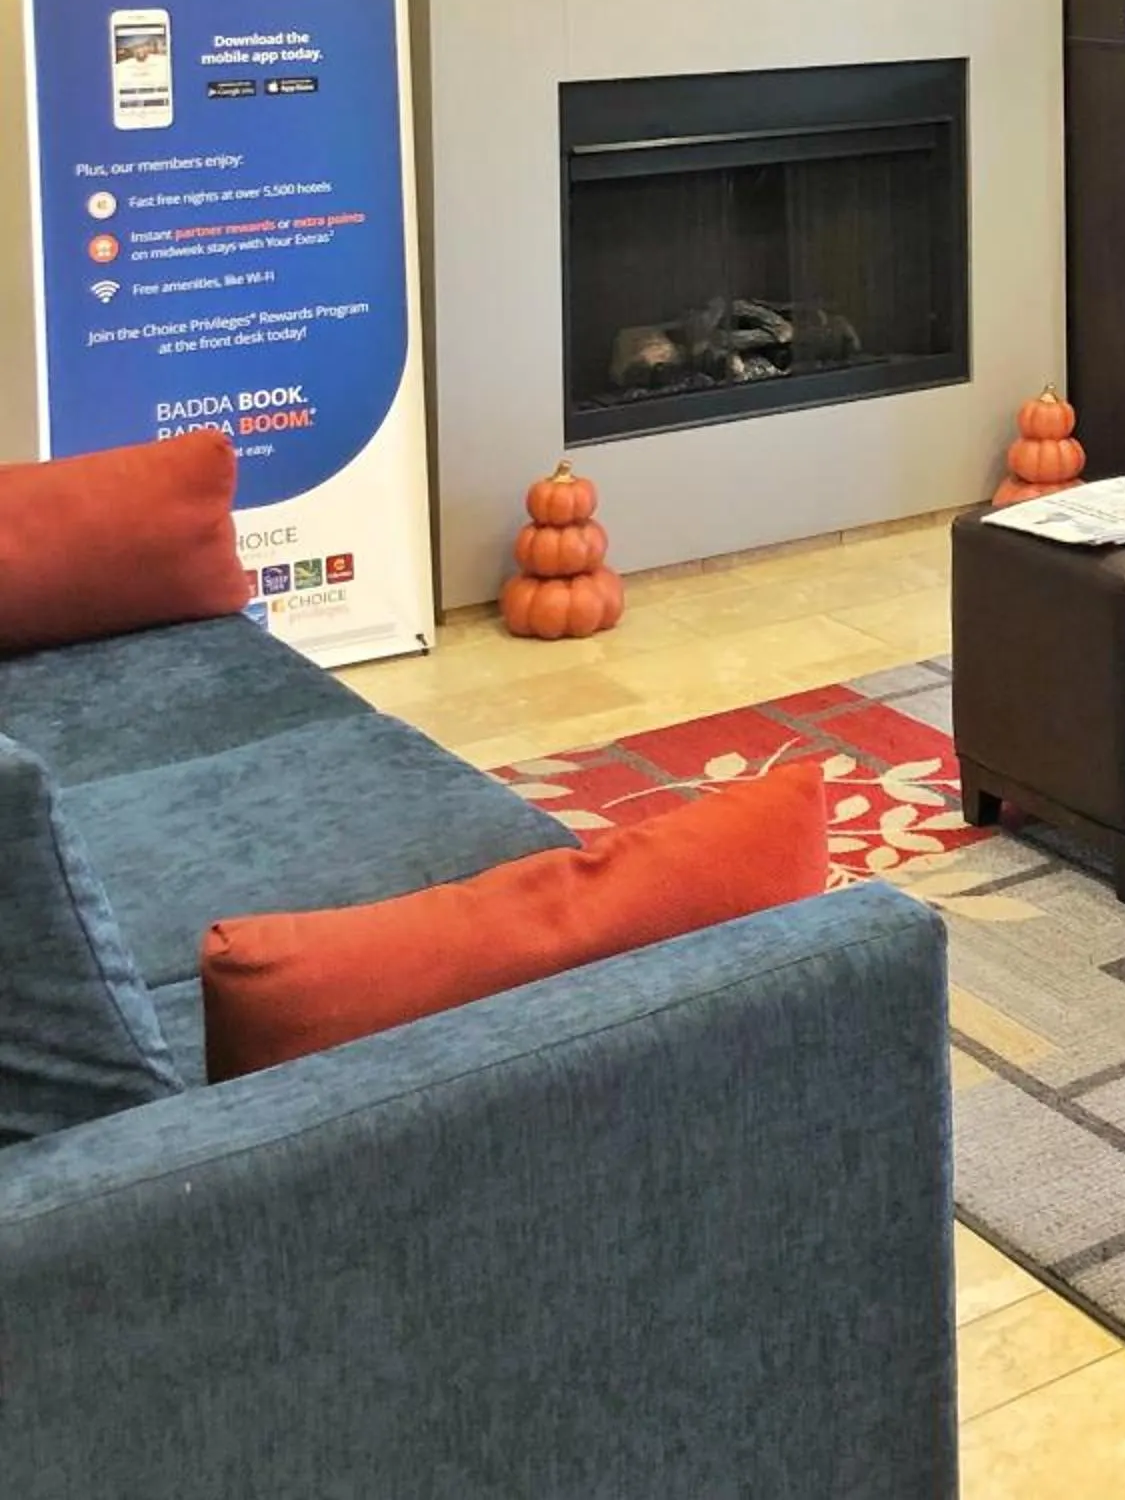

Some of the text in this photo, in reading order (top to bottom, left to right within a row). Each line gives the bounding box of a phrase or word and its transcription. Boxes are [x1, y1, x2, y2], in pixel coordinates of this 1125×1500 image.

[213, 31, 310, 47] Download the
[201, 47, 324, 65] mobile app today.
[76, 163, 109, 177] Plus,
[110, 163, 134, 175] our
[138, 156, 203, 173] members
[221, 190, 234, 201] at
[235, 189, 261, 200] over
[297, 181, 333, 195] hotels
[131, 230, 172, 243] Instant
[175, 224, 224, 241] partner
[225, 219, 277, 235] rewards
[277, 219, 291, 229] or
[131, 249, 149, 261] on
[150, 244, 206, 259] midweek
[207, 242, 237, 256] stays
[239, 238, 265, 251] with
[266, 236, 293, 248] Your
[132, 283, 160, 296] Free
[224, 274, 245, 287] like
[246, 270, 275, 284] Wi-Fi
[86, 329, 115, 346] Join
[117, 327, 140, 340] the
[142, 323, 188, 338] Choice
[259, 308, 314, 325] Rewards
[316, 302, 369, 319] Program
[158, 325, 308, 355] at the front desk today!
[157, 385, 309, 422] BADDA BOOK.
[287, 589, 346, 609] CHOICE
